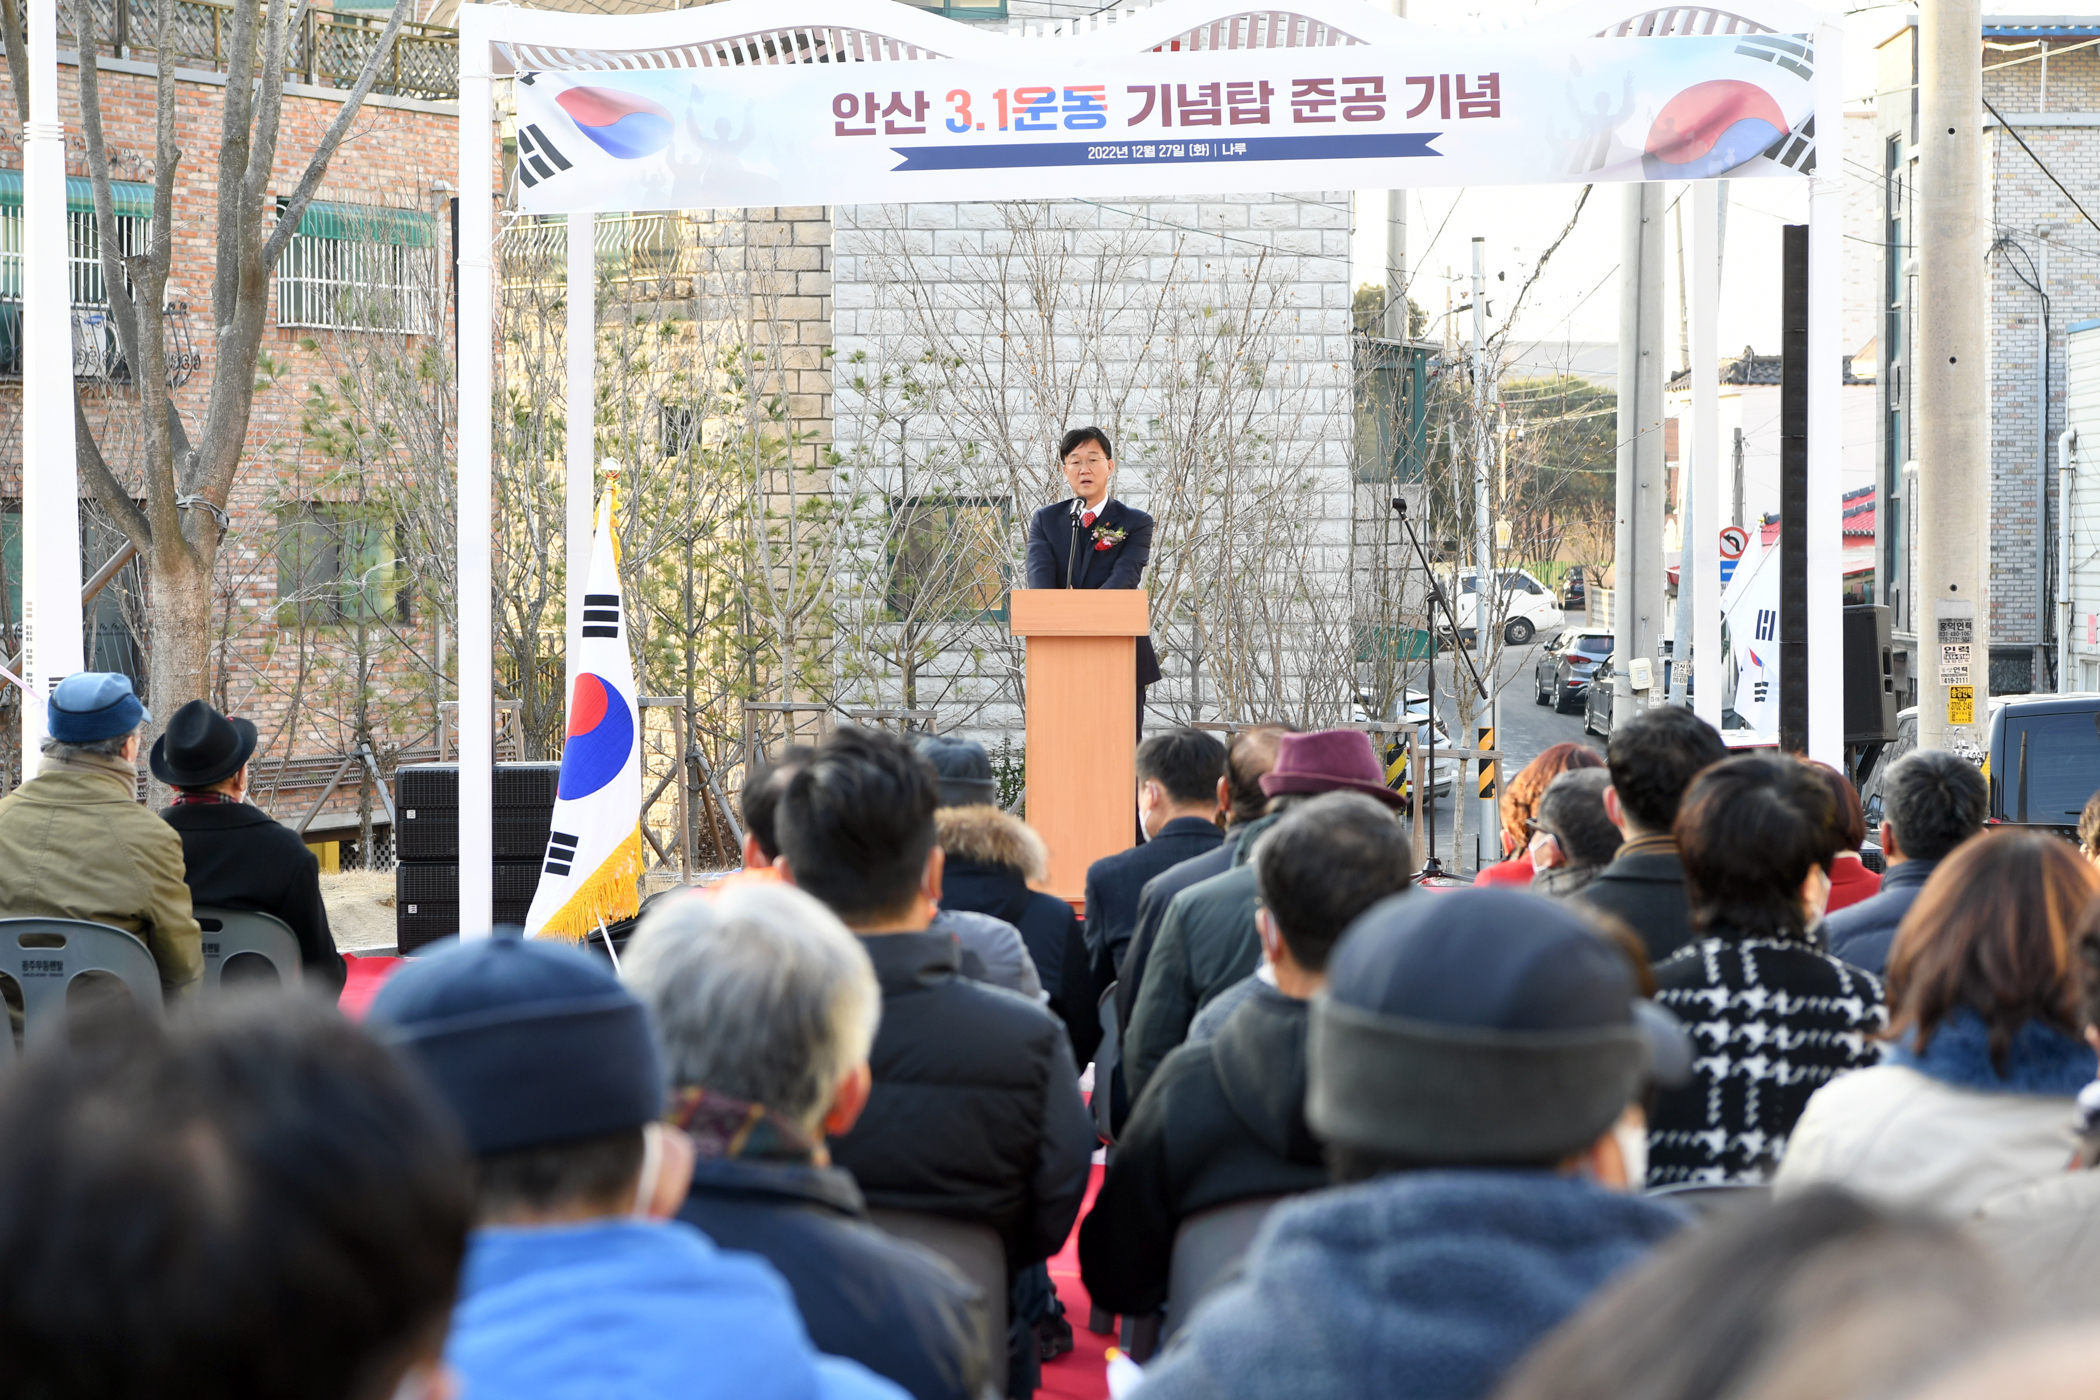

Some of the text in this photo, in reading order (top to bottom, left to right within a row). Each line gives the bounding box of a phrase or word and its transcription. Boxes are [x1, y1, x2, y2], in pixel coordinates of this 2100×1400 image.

[832, 71, 1501, 136] 안산 3.1운동 기념탑 준공 기념
[1088, 145, 1128, 159] 2022년
[1132, 144, 1156, 158] 12월
[1159, 143, 1185, 157] 27일
[1222, 142, 1247, 156] 나루
[1940, 621, 1972, 631] 홍익인력
[1944, 645, 1970, 654] 인력
